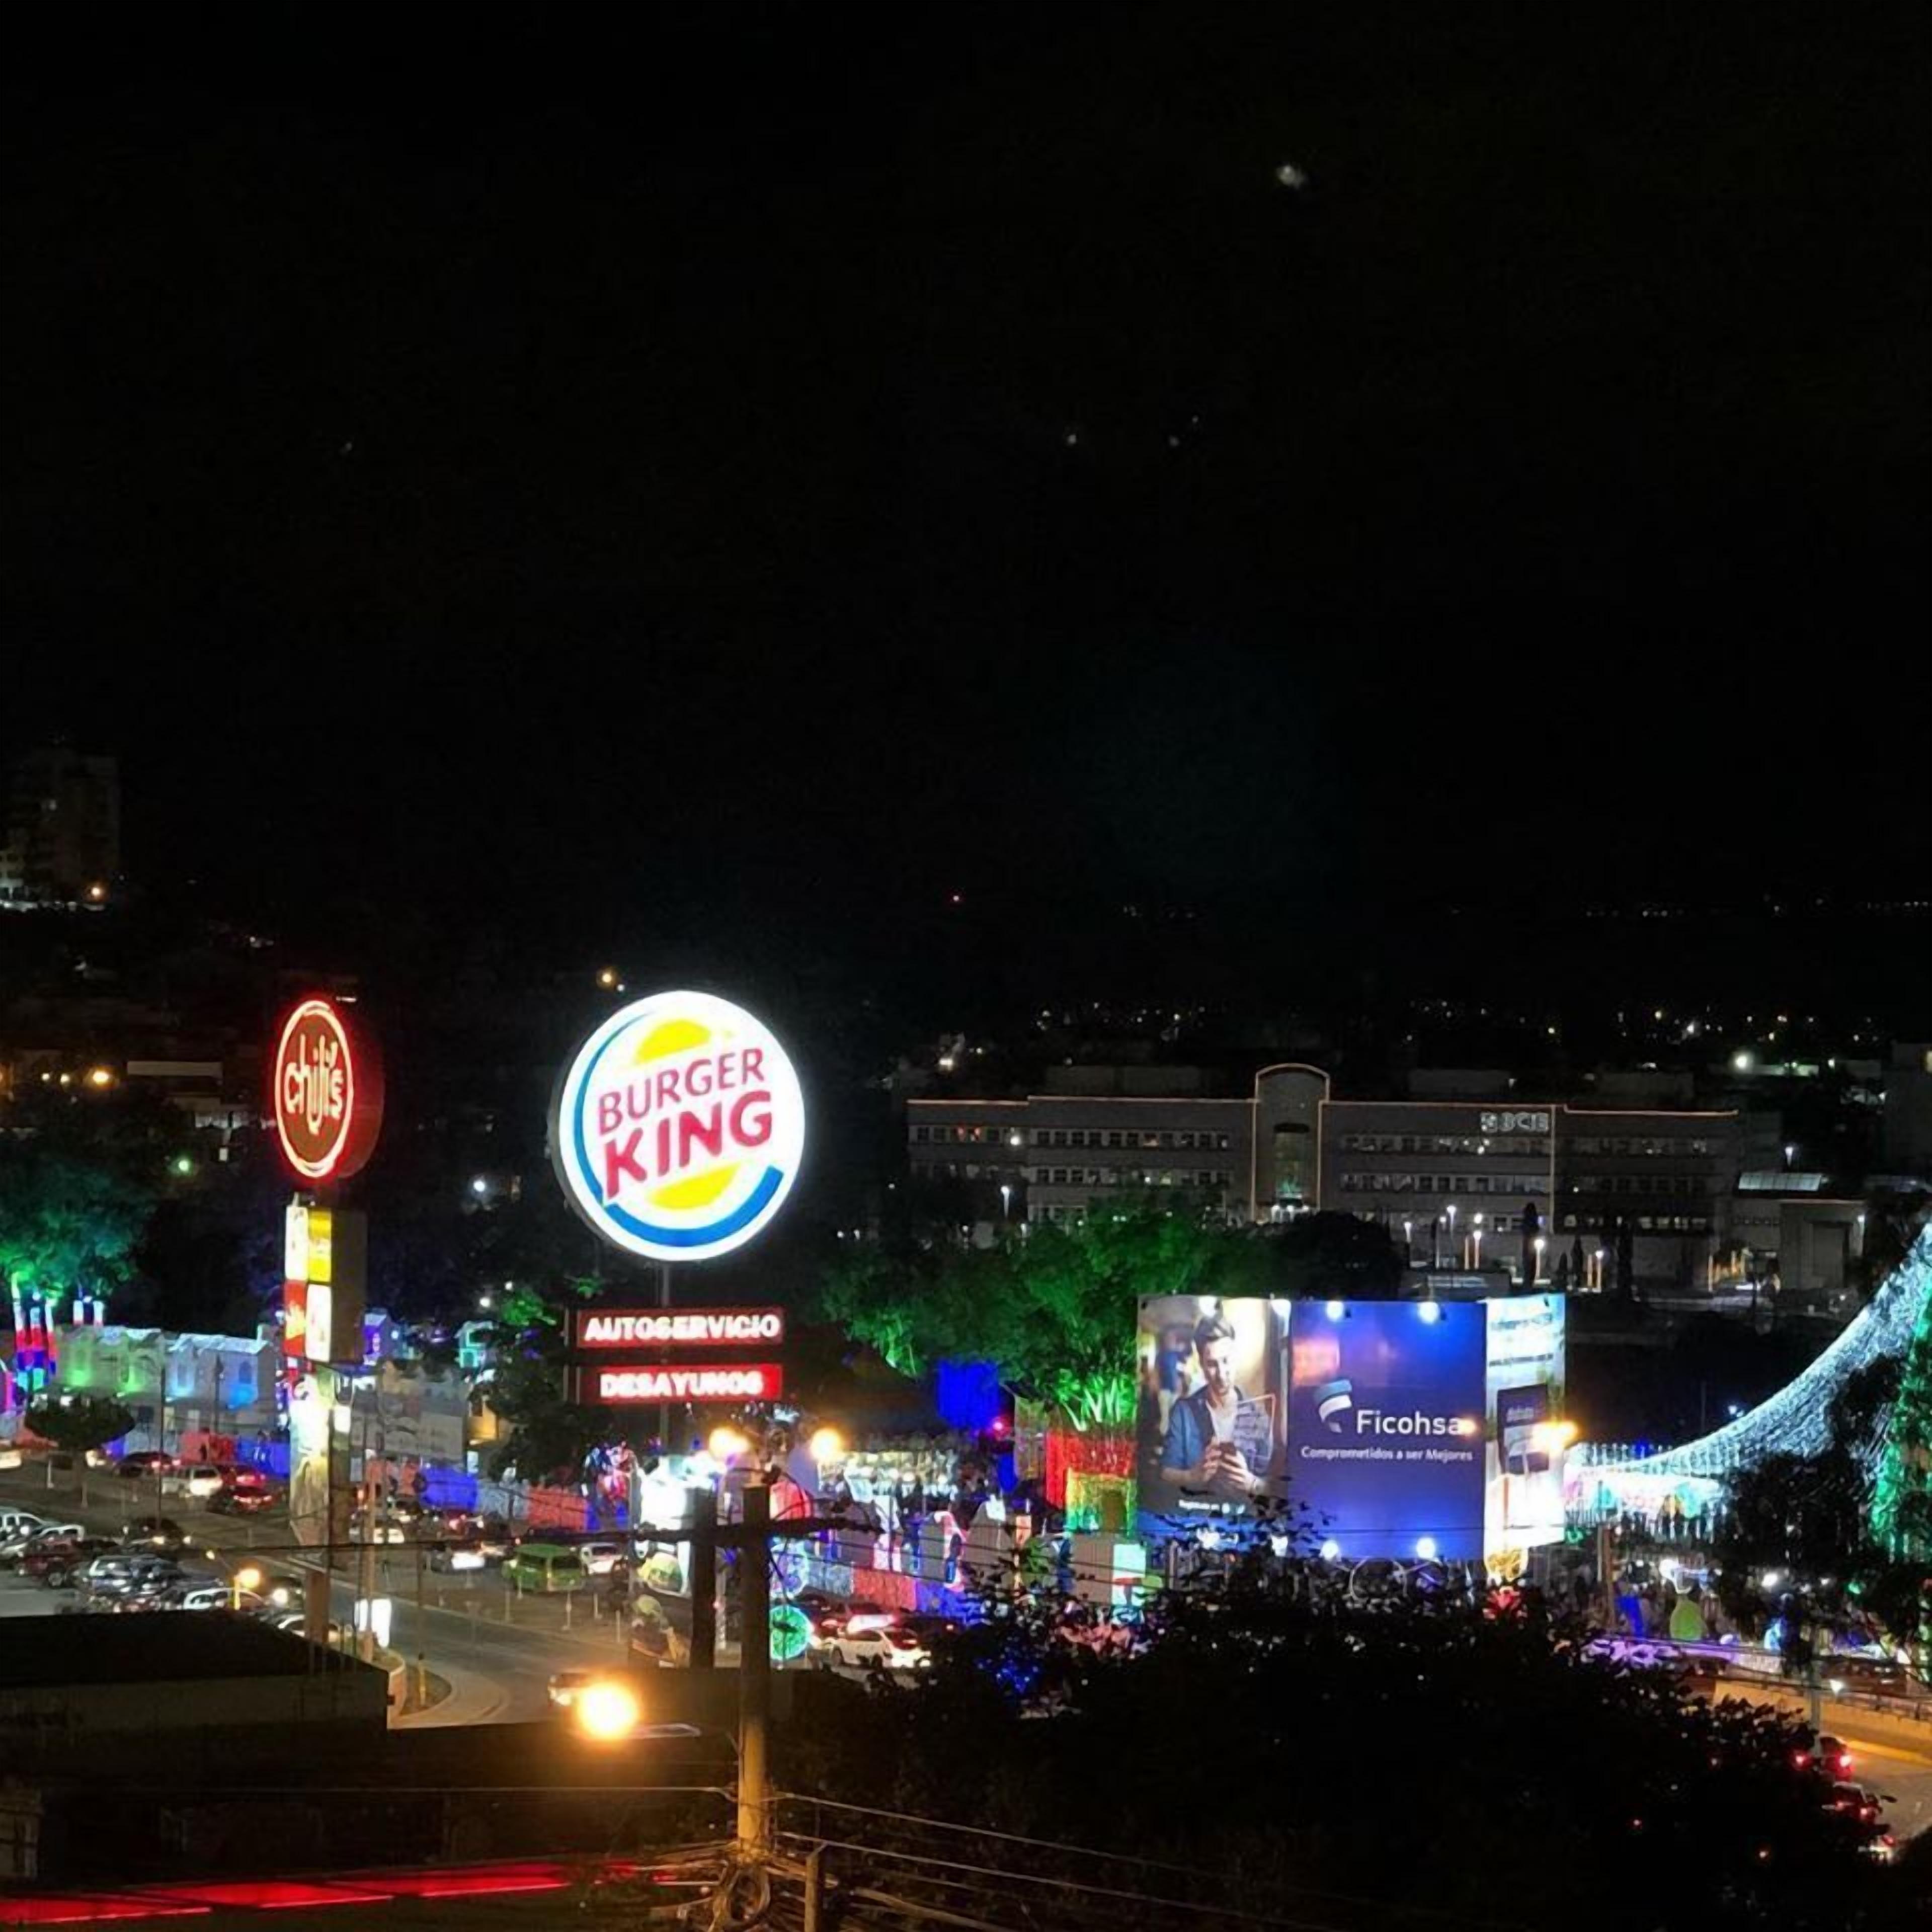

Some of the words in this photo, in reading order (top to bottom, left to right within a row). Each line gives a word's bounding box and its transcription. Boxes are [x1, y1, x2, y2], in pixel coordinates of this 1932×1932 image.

[598, 1048, 765, 1136] BURGER
[605, 1090, 773, 1200] KING
[584, 1314, 781, 1341] AUTOSERVICIO
[600, 1370, 764, 1398] DESAYUNOS
[1356, 1409, 1463, 1435] Ficohsa
[1301, 1445, 1393, 1461] Comprometidos
